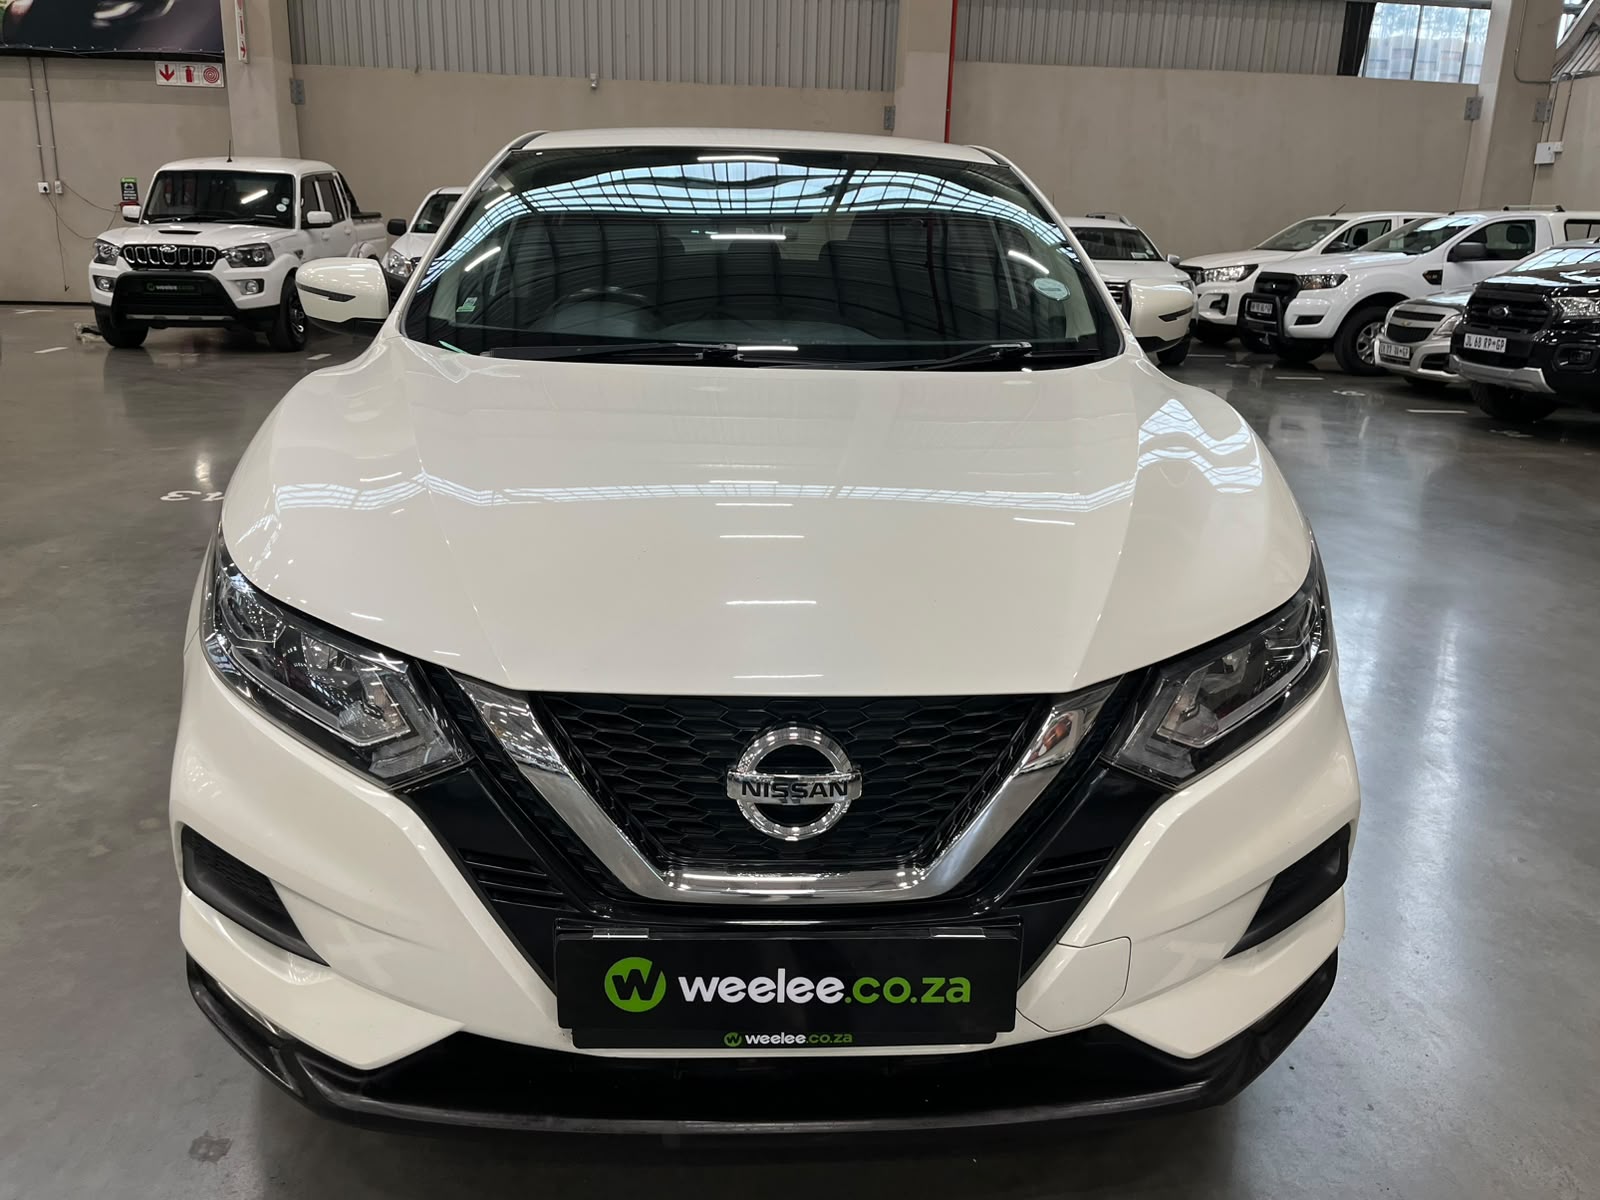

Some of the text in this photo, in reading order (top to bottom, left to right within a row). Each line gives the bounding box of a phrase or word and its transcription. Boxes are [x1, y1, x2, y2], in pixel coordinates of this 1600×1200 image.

[1496, 339, 1505, 351] GP
[741, 781, 848, 798] NISSAN
[677, 968, 971, 1005] weelee.co.za
[745, 1032, 853, 1045] weelee.co.za
